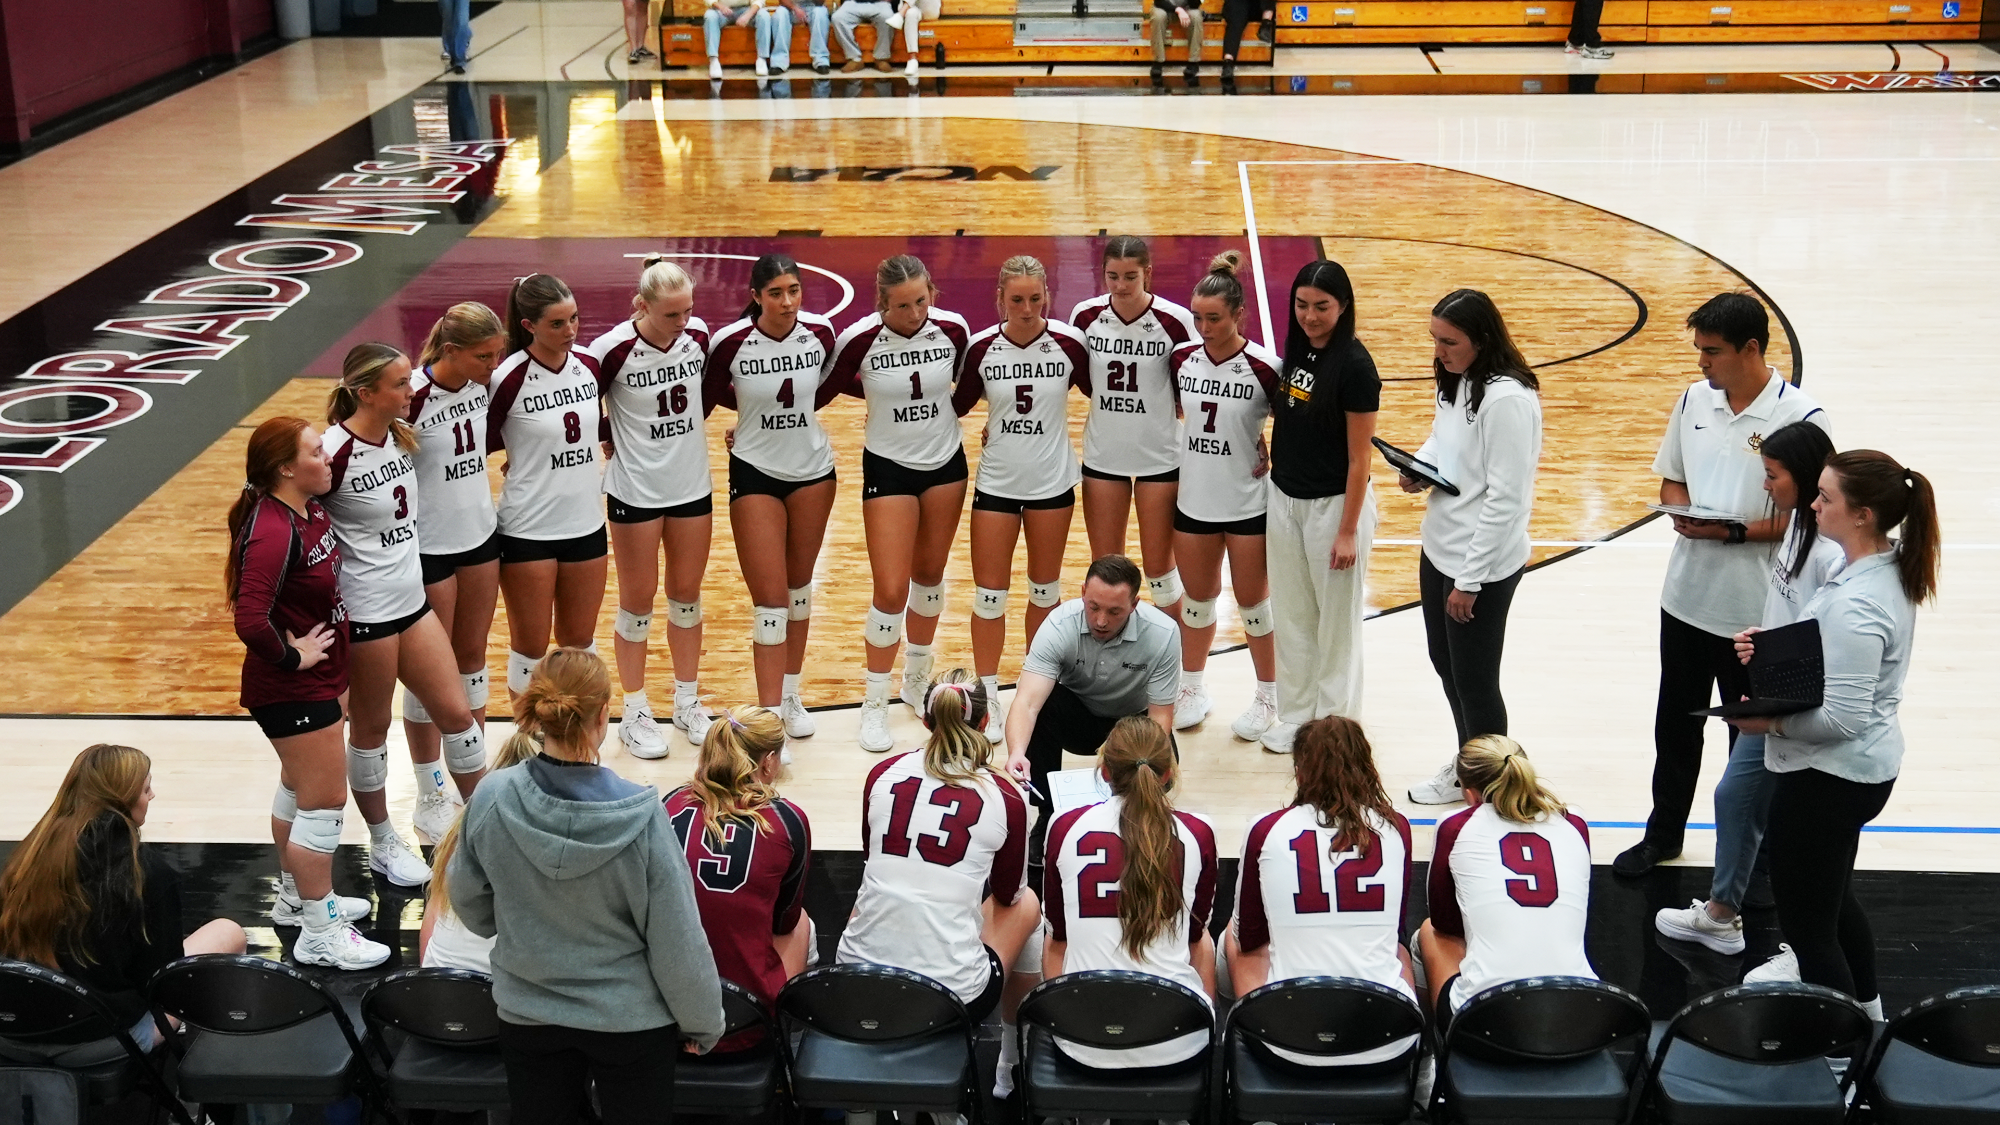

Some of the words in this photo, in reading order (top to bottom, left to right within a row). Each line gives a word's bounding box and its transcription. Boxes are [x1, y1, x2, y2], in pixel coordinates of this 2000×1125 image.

[768, 165, 1062, 182] NCAA
[0, 237, 364, 515] LORADO
[234, 138, 516, 235] MESA
[870, 348, 951, 371] COLORADO
[1088, 336, 1166, 357] COLORADO
[626, 359, 702, 388] COLORADO
[739, 350, 821, 375] COLORADO
[984, 362, 1065, 381] COLORADO
[1107, 360, 1139, 393] 21
[522, 381, 598, 413] COLORADO
[656, 383, 688, 417] 16
[776, 378, 795, 409] 4
[909, 371, 924, 400] 1
[1015, 384, 1034, 414] 5
[1178, 375, 1254, 401] COLORADO
[893, 402, 939, 423] MESA
[1099, 395, 1147, 414] MESA
[1200, 401, 1218, 434] 7
[563, 411, 581, 444] 8
[650, 417, 694, 439] MESA
[761, 413, 808, 430] MESA
[1000, 419, 1044, 435] MESA
[452, 418, 476, 456] 11
[1188, 436, 1232, 456] MESA
[351, 453, 413, 493] COLORAD
[445, 455, 484, 482] MESA
[551, 447, 593, 470] MESA
[393, 484, 408, 520] 3
[380, 519, 416, 547] MES
[881, 775, 984, 867] 13
[670, 806, 757, 893] 19
[1289, 829, 1385, 914] 12
[1499, 831, 1558, 908] 9
